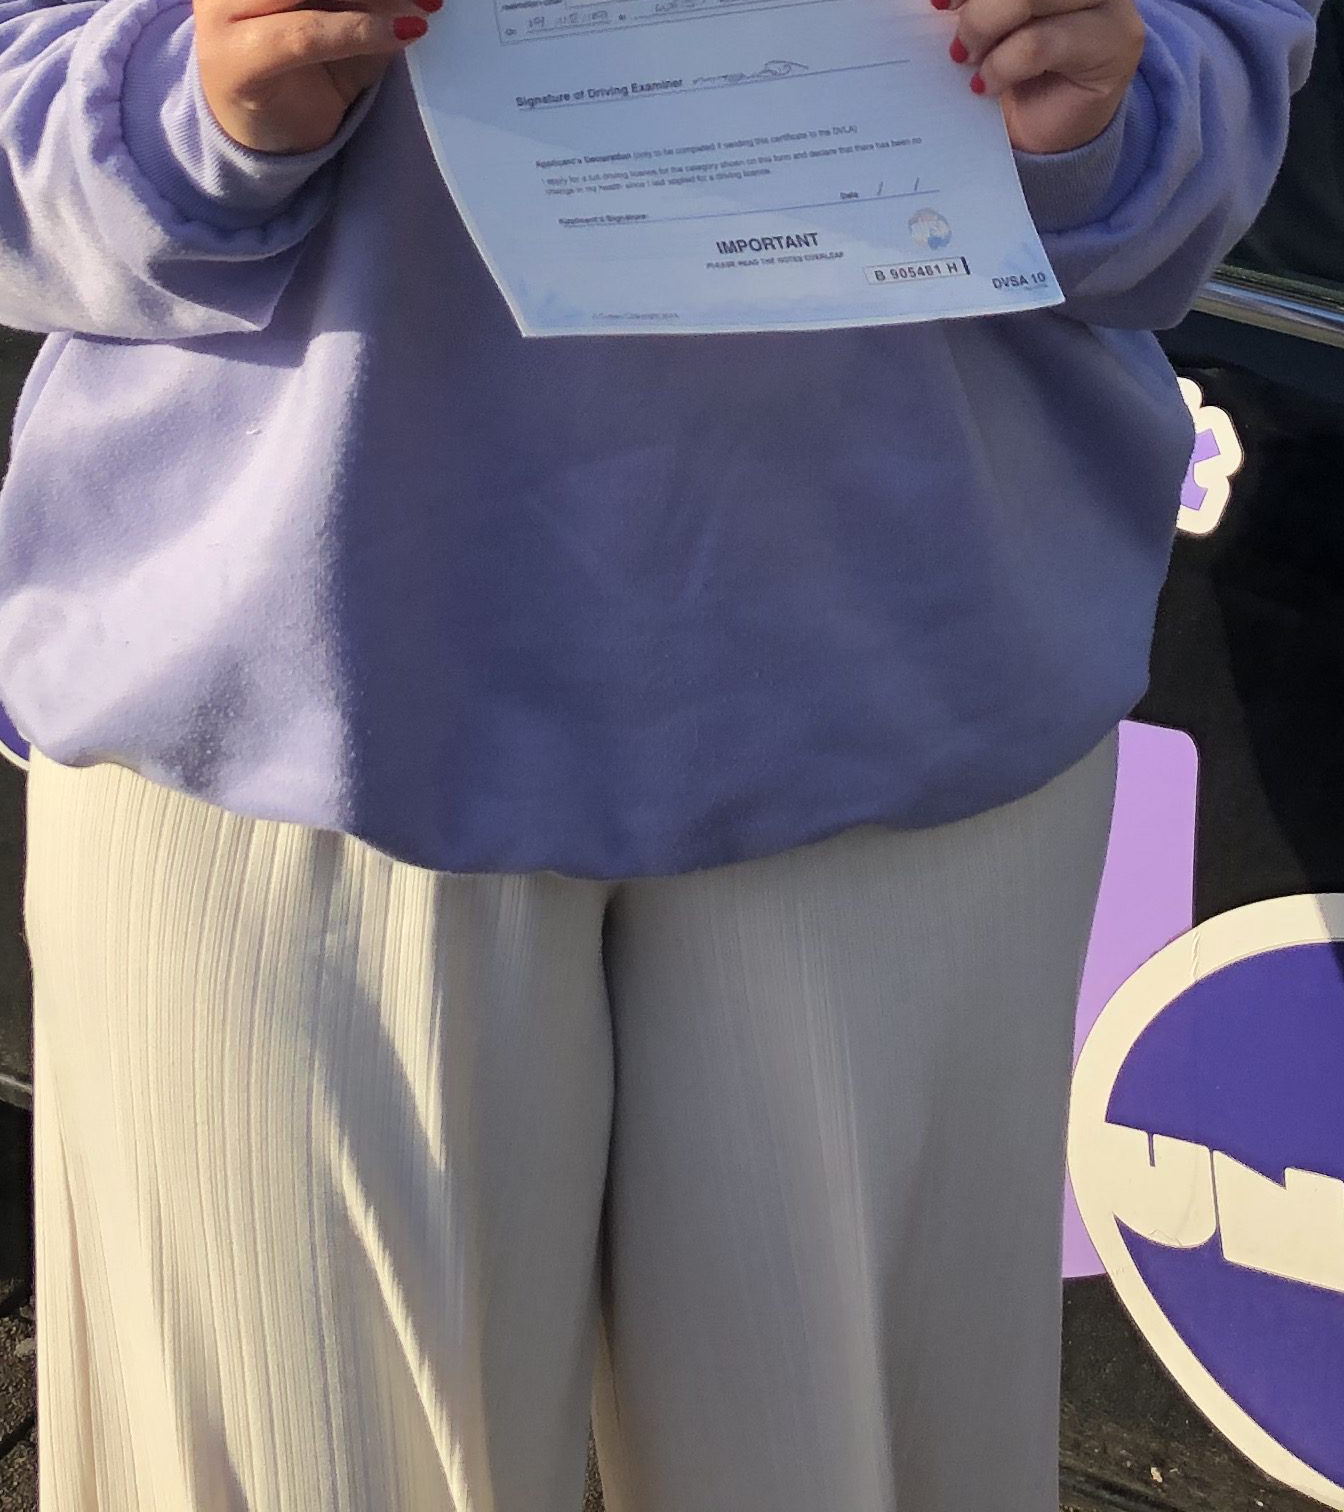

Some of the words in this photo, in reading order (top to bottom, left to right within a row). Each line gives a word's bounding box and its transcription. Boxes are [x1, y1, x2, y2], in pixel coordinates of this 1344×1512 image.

[516, 92, 570, 108] Signature
[573, 90, 584, 100] of
[587, 86, 628, 99] Driving
[630, 79, 683, 93] Examiner
[715, 232, 820, 255] IMPORTANT
[874, 269, 886, 282] B
[890, 264, 942, 280] 905481
[947, 261, 958, 274] H
[991, 274, 1028, 289] DVSA
[1031, 271, 1047, 284] 10
